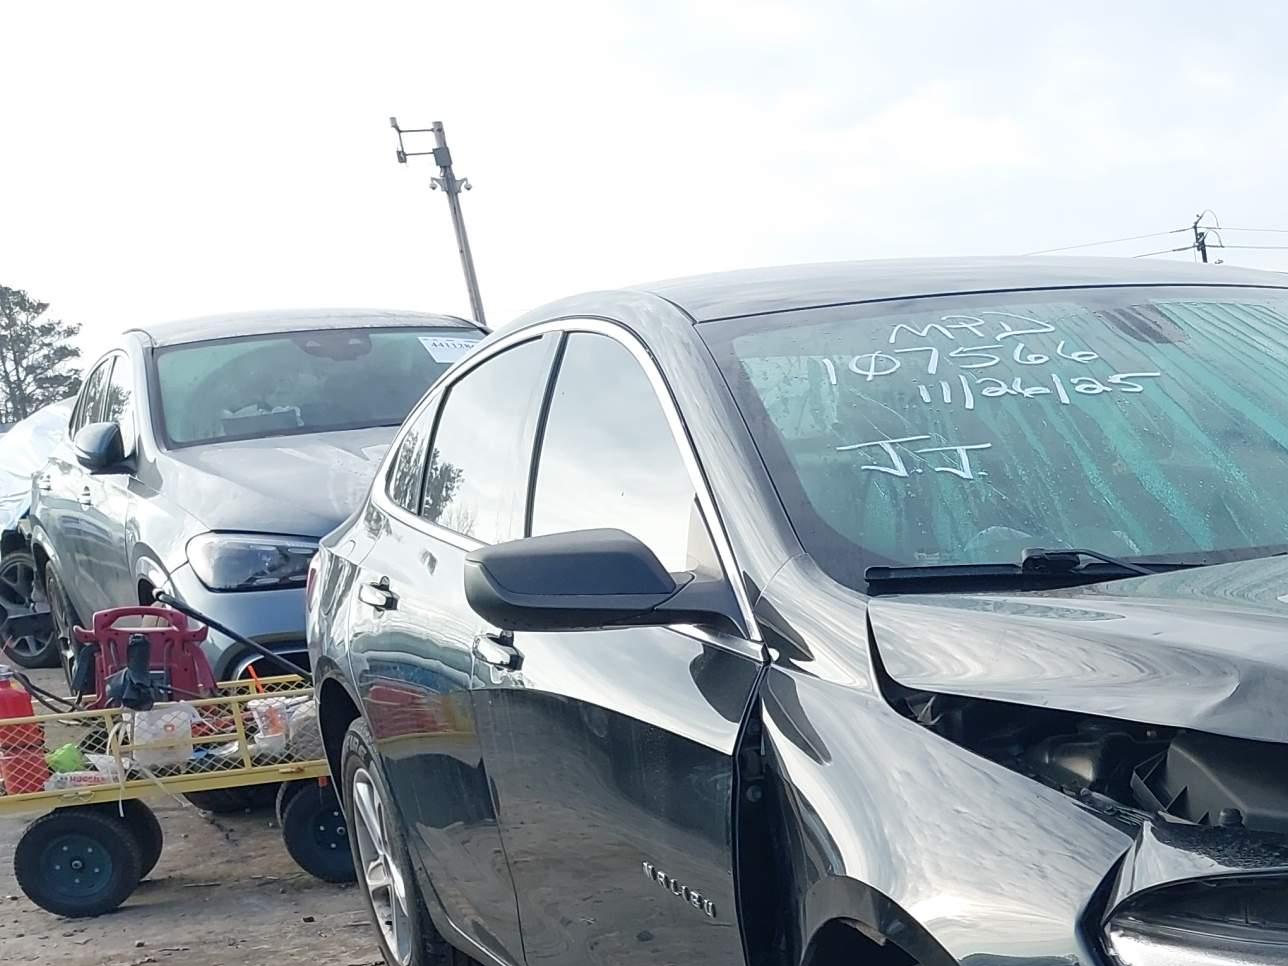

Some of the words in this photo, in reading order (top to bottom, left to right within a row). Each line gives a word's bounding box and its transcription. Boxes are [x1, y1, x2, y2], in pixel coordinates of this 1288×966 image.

[822, 340, 1100, 385] 107566
[917, 372, 1161, 409] 11/26/25
[642, 861, 717, 919] MALIBU
